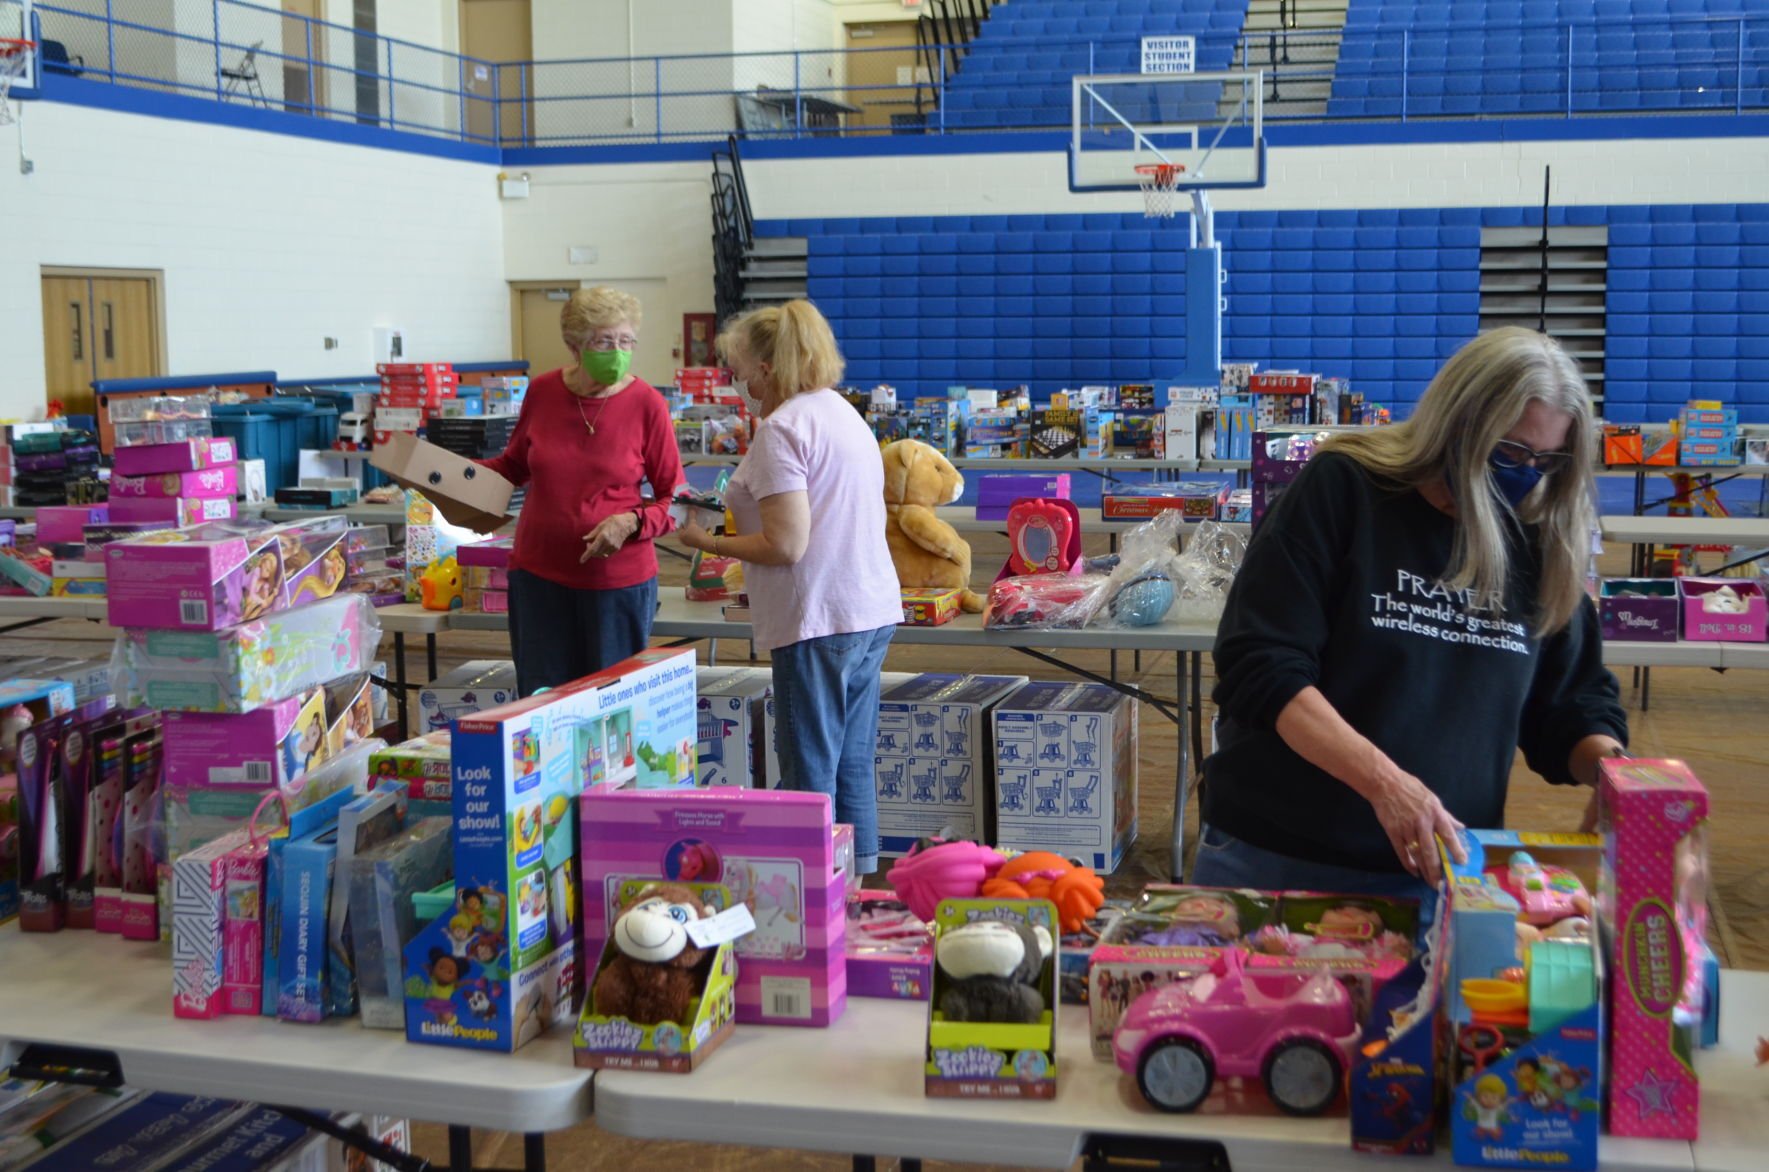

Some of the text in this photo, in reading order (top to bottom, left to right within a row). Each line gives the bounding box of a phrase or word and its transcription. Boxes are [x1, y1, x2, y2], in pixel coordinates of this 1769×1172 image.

[1147, 41, 1190, 50] VISITOR
[1144, 52, 1191, 61] STUDENT
[1145, 63, 1191, 73] SECTION
[1397, 569, 1508, 612] PRAYER
[1371, 592, 1526, 637] The world's greatest
[1371, 613, 1439, 638] wireless
[599, 692, 616, 709] Little
[617, 687, 633, 702] ones
[634, 680, 647, 695] who
[648, 674, 661, 689] visit
[661, 669, 674, 684] this
[457, 766, 492, 781] Look
[465, 782, 487, 797] for
[466, 801, 490, 813] our
[458, 815, 501, 830] show!
[227, 860, 260, 877] Barbie
[294, 871, 311, 1003] SEQUIN DIARY GIFT SET
[1646, 914, 1672, 1003] CHEERS
[518, 961, 549, 986] Connect
[1525, 1117, 1568, 1129] Look for
[244, 1132, 286, 1159] and
